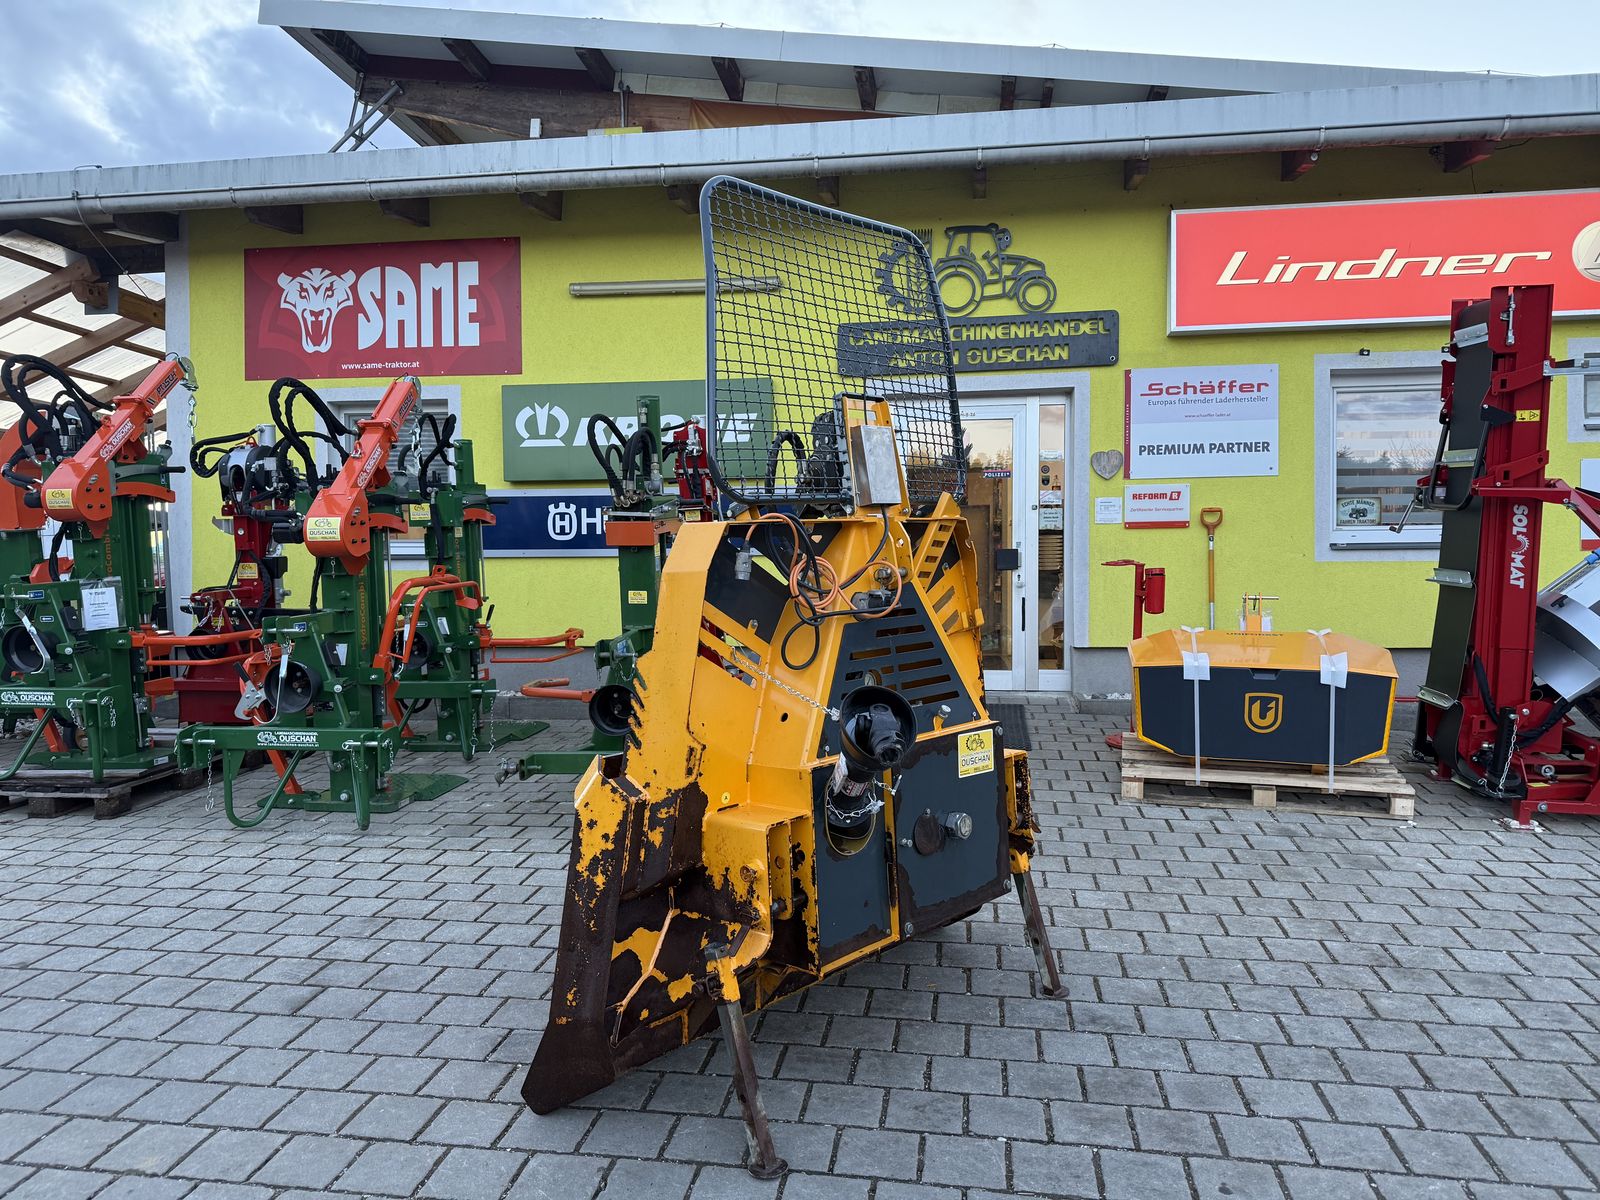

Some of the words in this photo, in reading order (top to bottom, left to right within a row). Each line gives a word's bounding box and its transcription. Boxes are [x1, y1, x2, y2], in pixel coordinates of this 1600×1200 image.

[1216, 248, 1552, 286] Lindner
[357, 260, 480, 350] SAME
[966, 343, 1070, 365] OUSCHAN
[341, 360, 420, 370] www.same-traktor.at
[1140, 379, 1270, 397] Schäffer
[1178, 397, 1214, 405] führender
[1215, 395, 1269, 403] Laderhersteller
[1138, 443, 1206, 456] PREMIUM
[1208, 441, 1271, 454] PARTNER
[1132, 492, 1168, 500] REFORM
[279, 735, 316, 743] OUSCHAN
[961, 754, 991, 767] OUSCHAN
